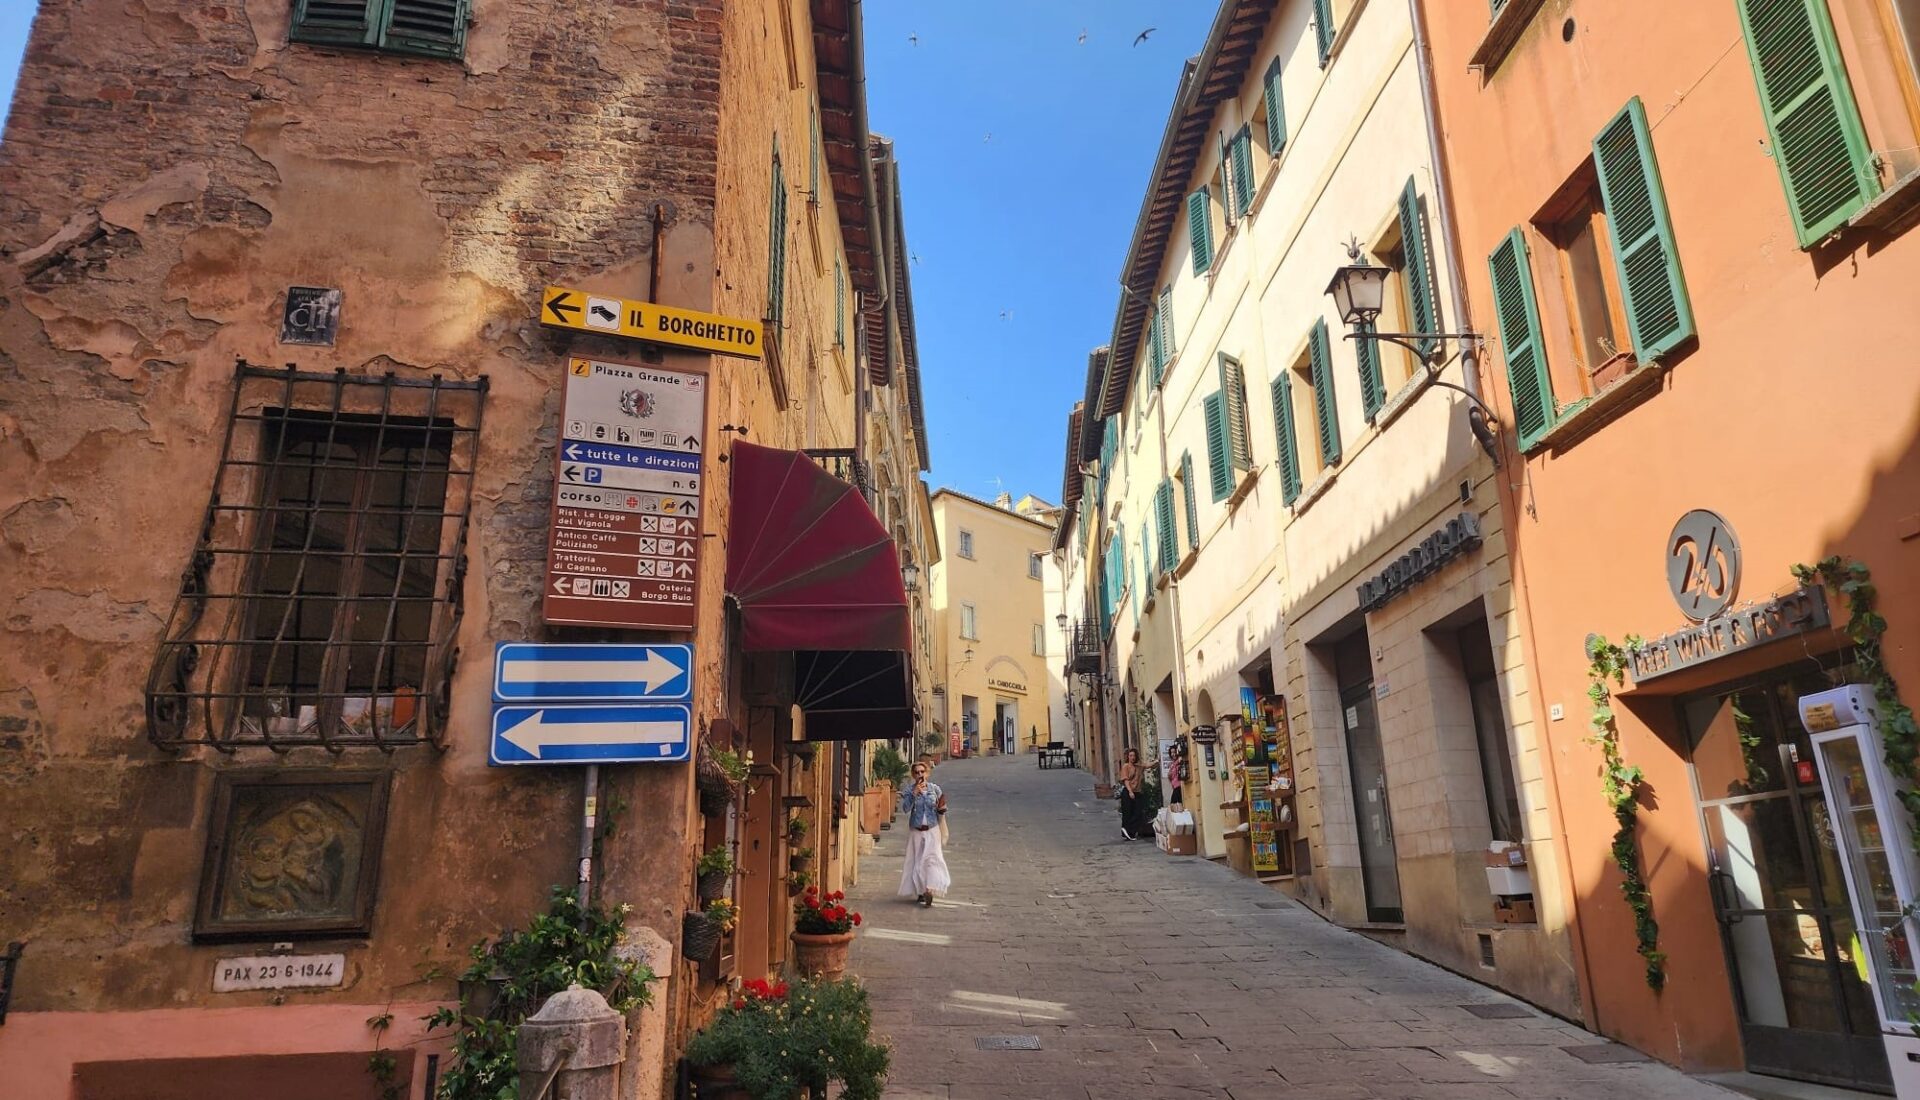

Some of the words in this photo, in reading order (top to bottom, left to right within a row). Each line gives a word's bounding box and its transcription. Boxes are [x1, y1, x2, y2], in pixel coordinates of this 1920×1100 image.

[630, 310, 644, 328] IL
[659, 315, 755, 345] BORGHETTO
[595, 365, 633, 378] Piazza
[638, 371, 680, 385] Grande
[587, 449, 621, 461] tutte
[627, 453, 639, 463] le
[645, 456, 699, 469] direzioni
[689, 480, 697, 489] 6
[560, 491, 601, 503] corso
[558, 509, 580, 517] Rist.
[599, 512, 626, 521] Logge
[577, 519, 611, 528] Vignola
[557, 531, 588, 540] Antico
[591, 533, 617, 542] Caffè
[555, 540, 598, 549] Poliziano
[555, 553, 596, 563] Trattoria
[566, 563, 607, 573] Cagnano
[659, 583, 692, 592] Osteria
[641, 591, 668, 600] Borgo
[672, 592, 691, 601] Buio
[1674, 625, 1725, 663] WINE
[1731, 618, 1748, 647] &
[224, 967, 252, 981] PAX
